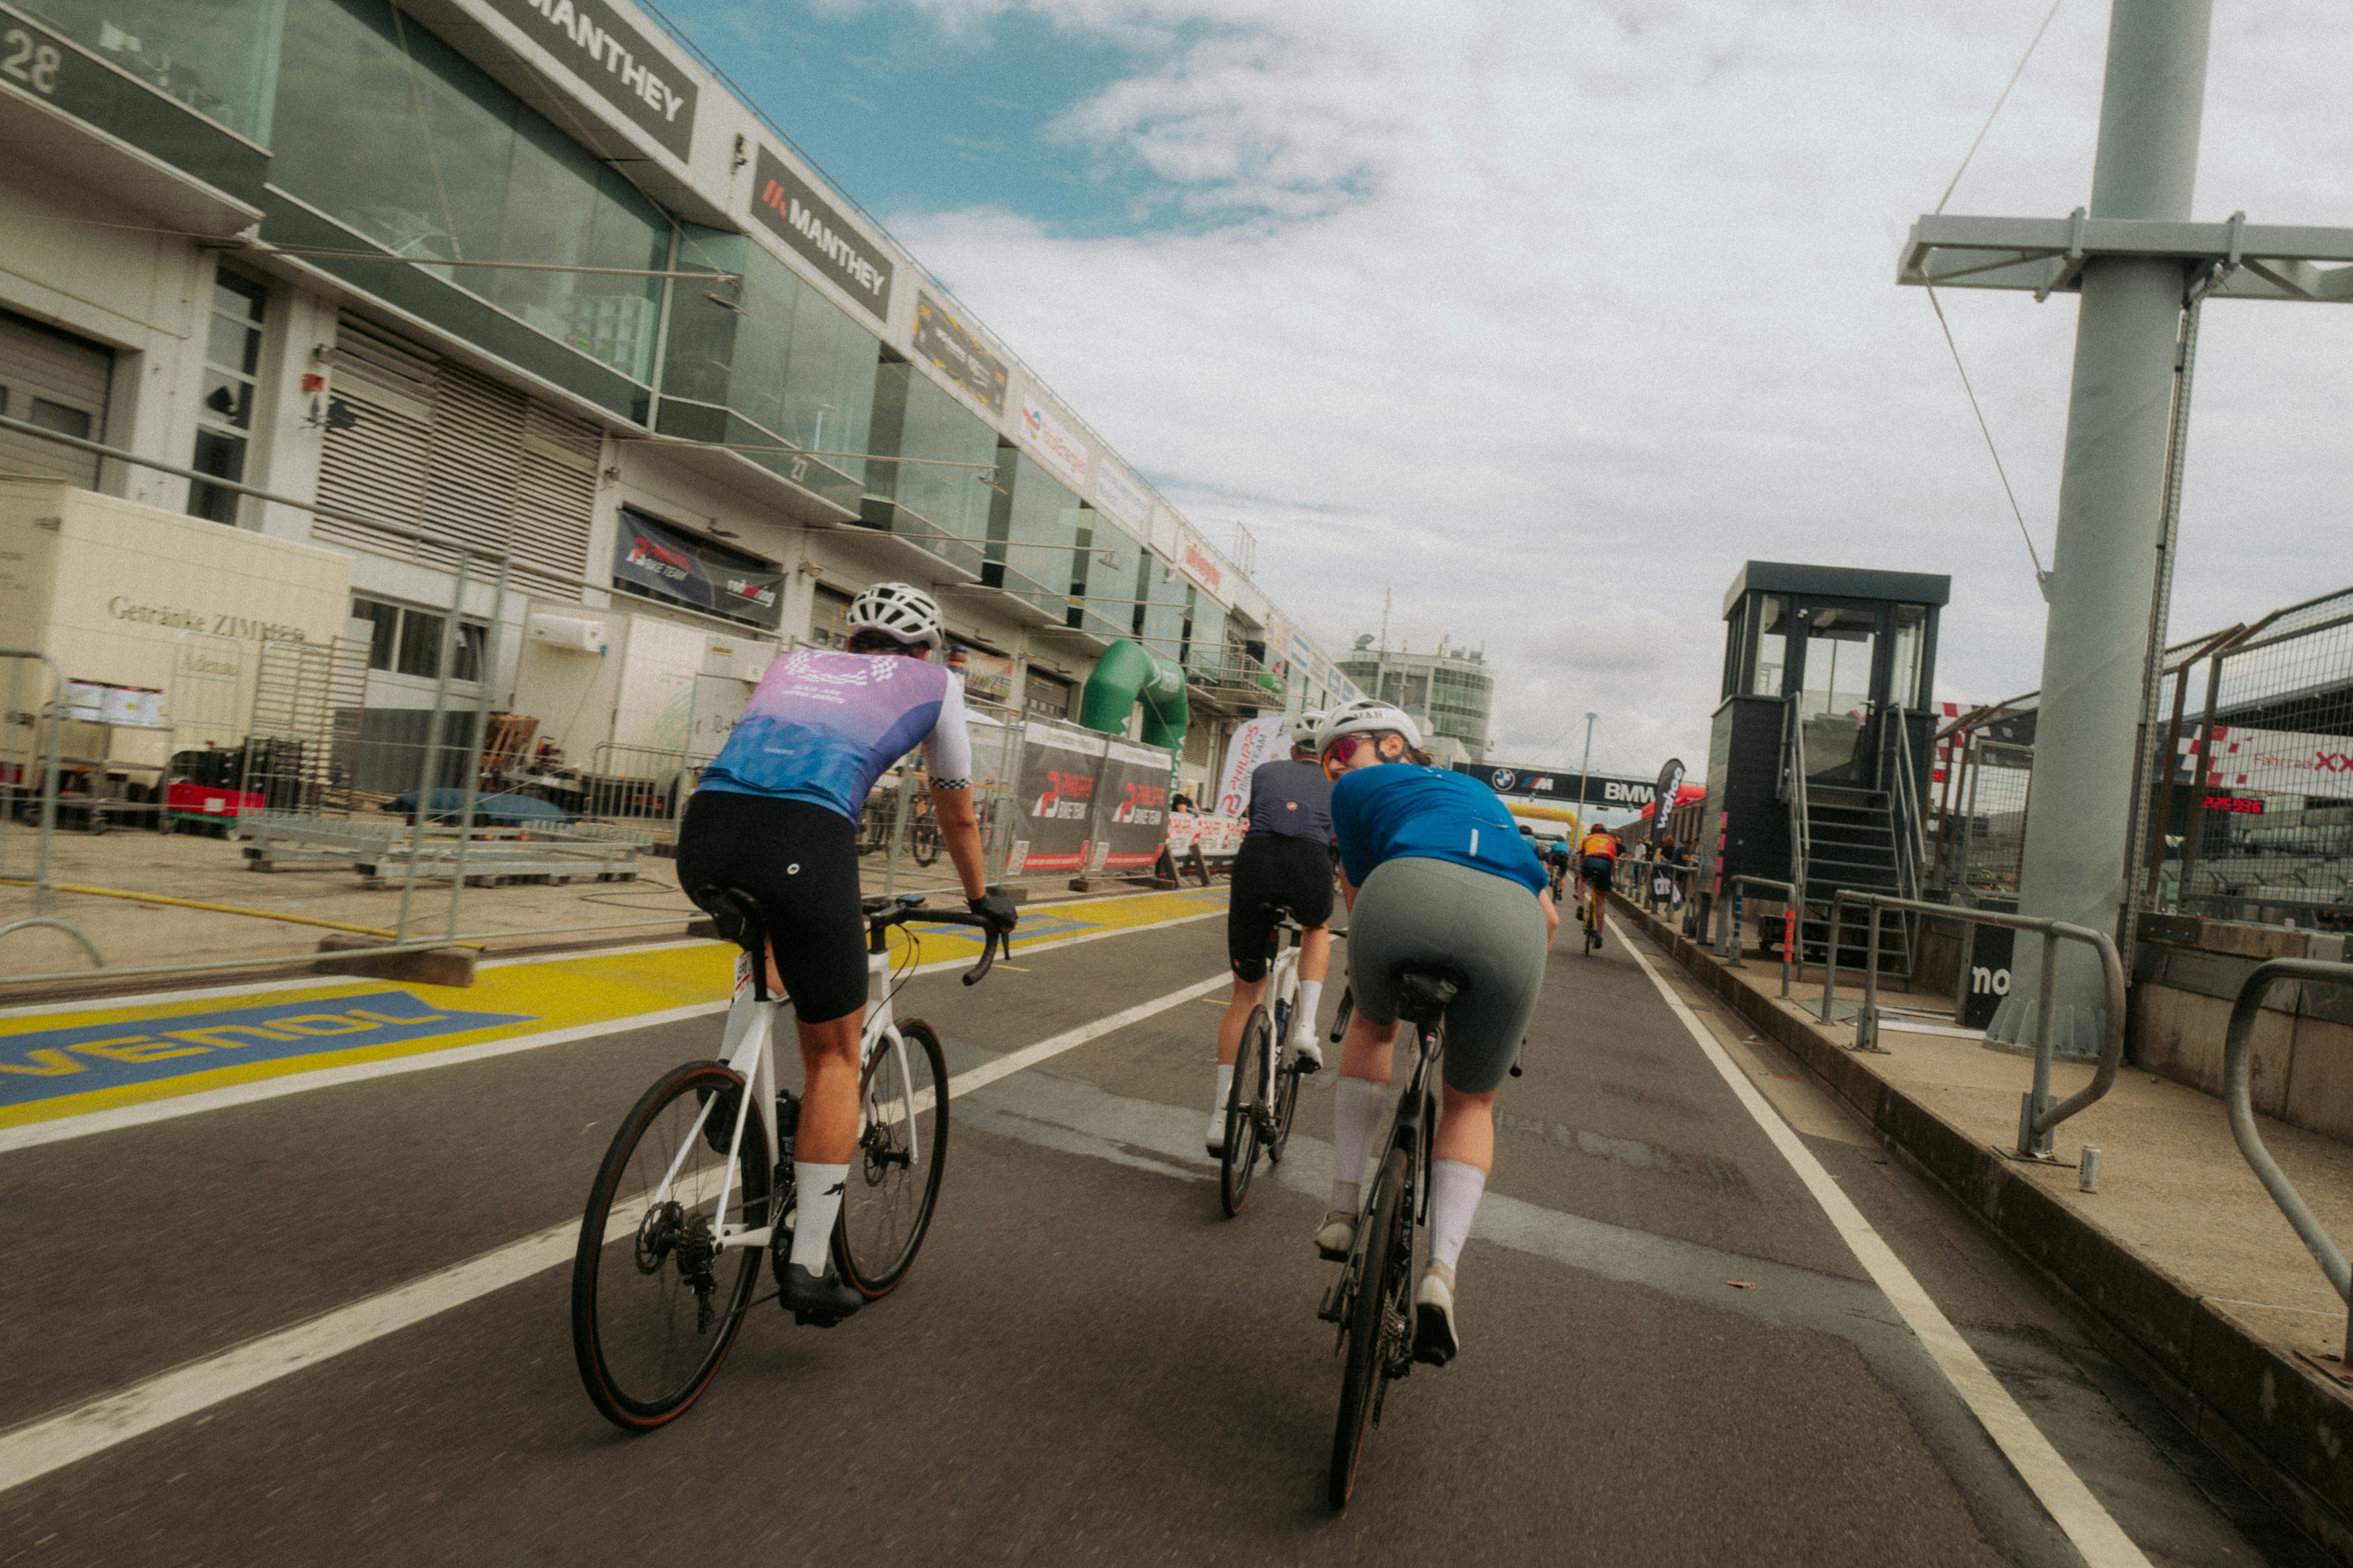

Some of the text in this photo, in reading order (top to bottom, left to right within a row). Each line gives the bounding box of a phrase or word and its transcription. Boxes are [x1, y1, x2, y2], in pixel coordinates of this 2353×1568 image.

[2, 29, 61, 94] 28
[789, 200, 885, 296] MANTHEY
[1604, 781, 1657, 803] BMW
[1656, 766, 1683, 829] wahoo
